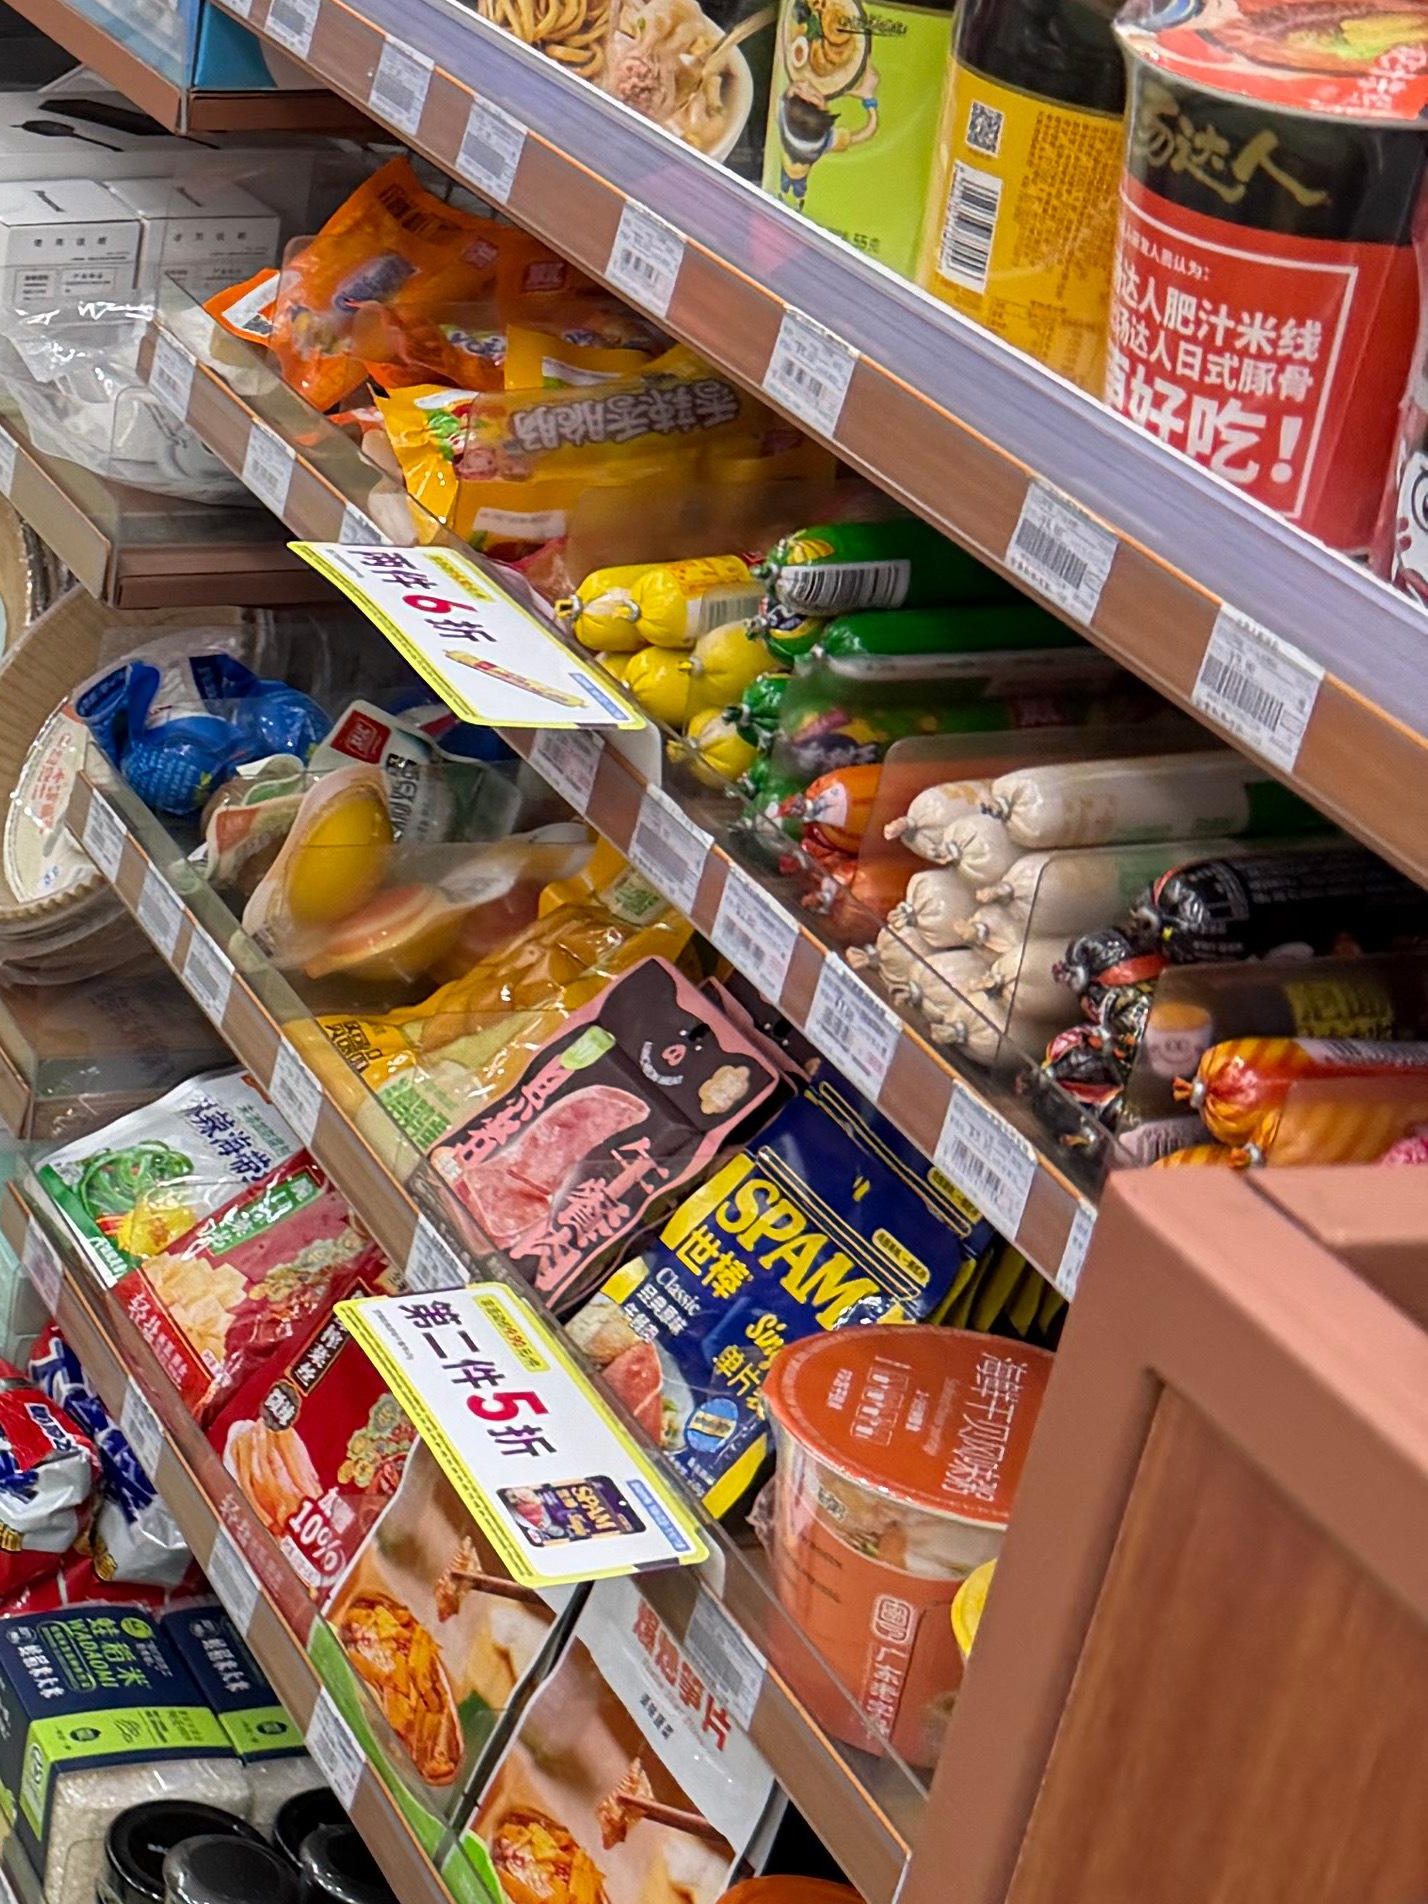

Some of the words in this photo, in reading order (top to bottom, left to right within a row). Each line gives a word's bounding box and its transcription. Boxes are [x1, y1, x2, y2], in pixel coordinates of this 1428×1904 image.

[510, 379, 739, 451] 香辣香脆肠
[347, 549, 497, 643] 两件6折
[673, 1225, 754, 1301] 世棒
[714, 1176, 883, 1328] SPAM
[654, 1266, 702, 1319] Classic
[397, 1300, 557, 1458] 第二件5折
[289, 1498, 343, 1574] 10%
[92, 1616, 148, 1690] 蛙稻米
